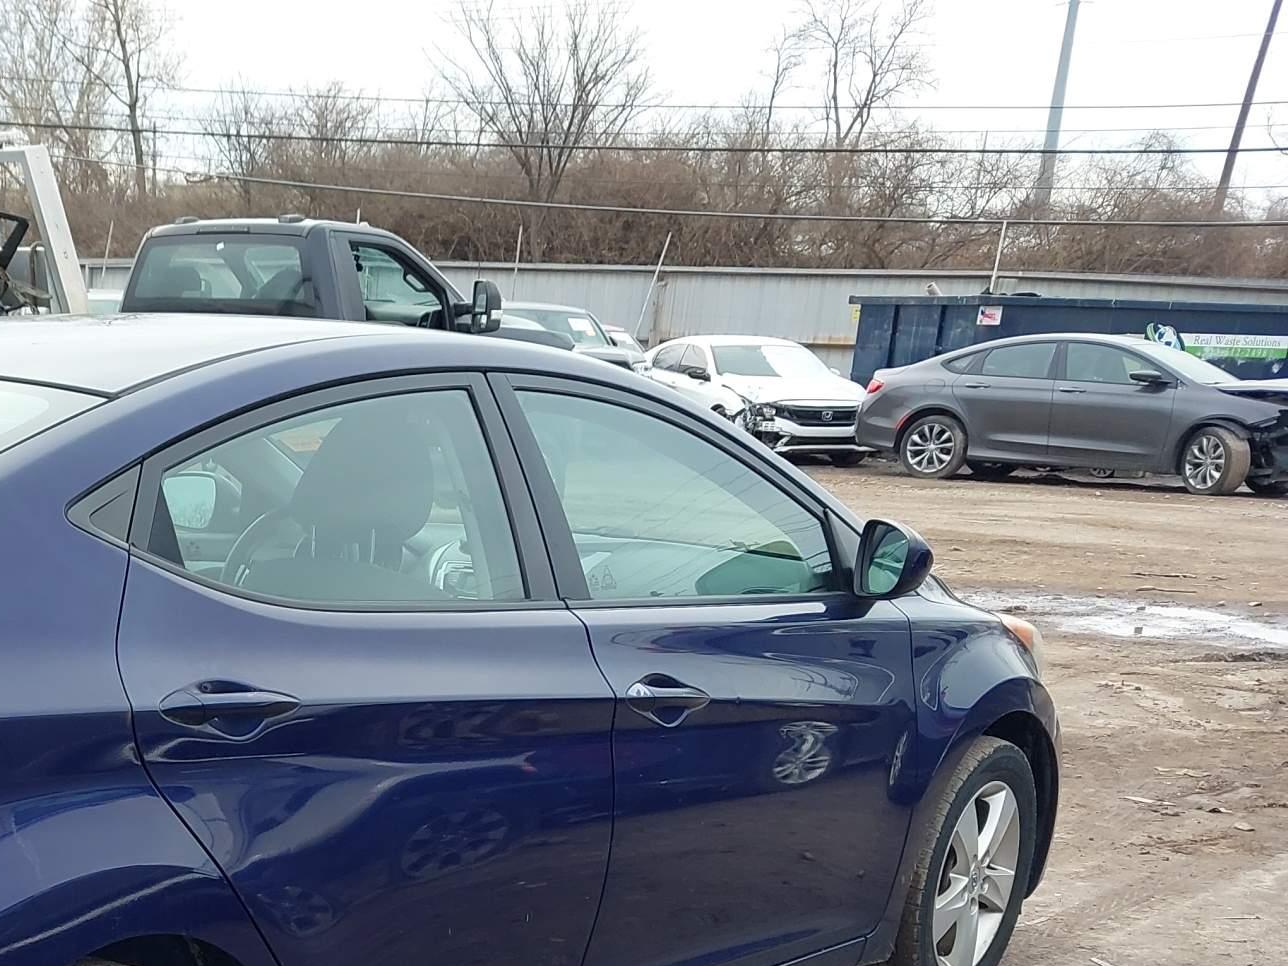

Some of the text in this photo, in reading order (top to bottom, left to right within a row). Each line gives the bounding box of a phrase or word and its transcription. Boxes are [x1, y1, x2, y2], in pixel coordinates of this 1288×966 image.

[1193, 335, 1281, 347] Real Waste Solutions
